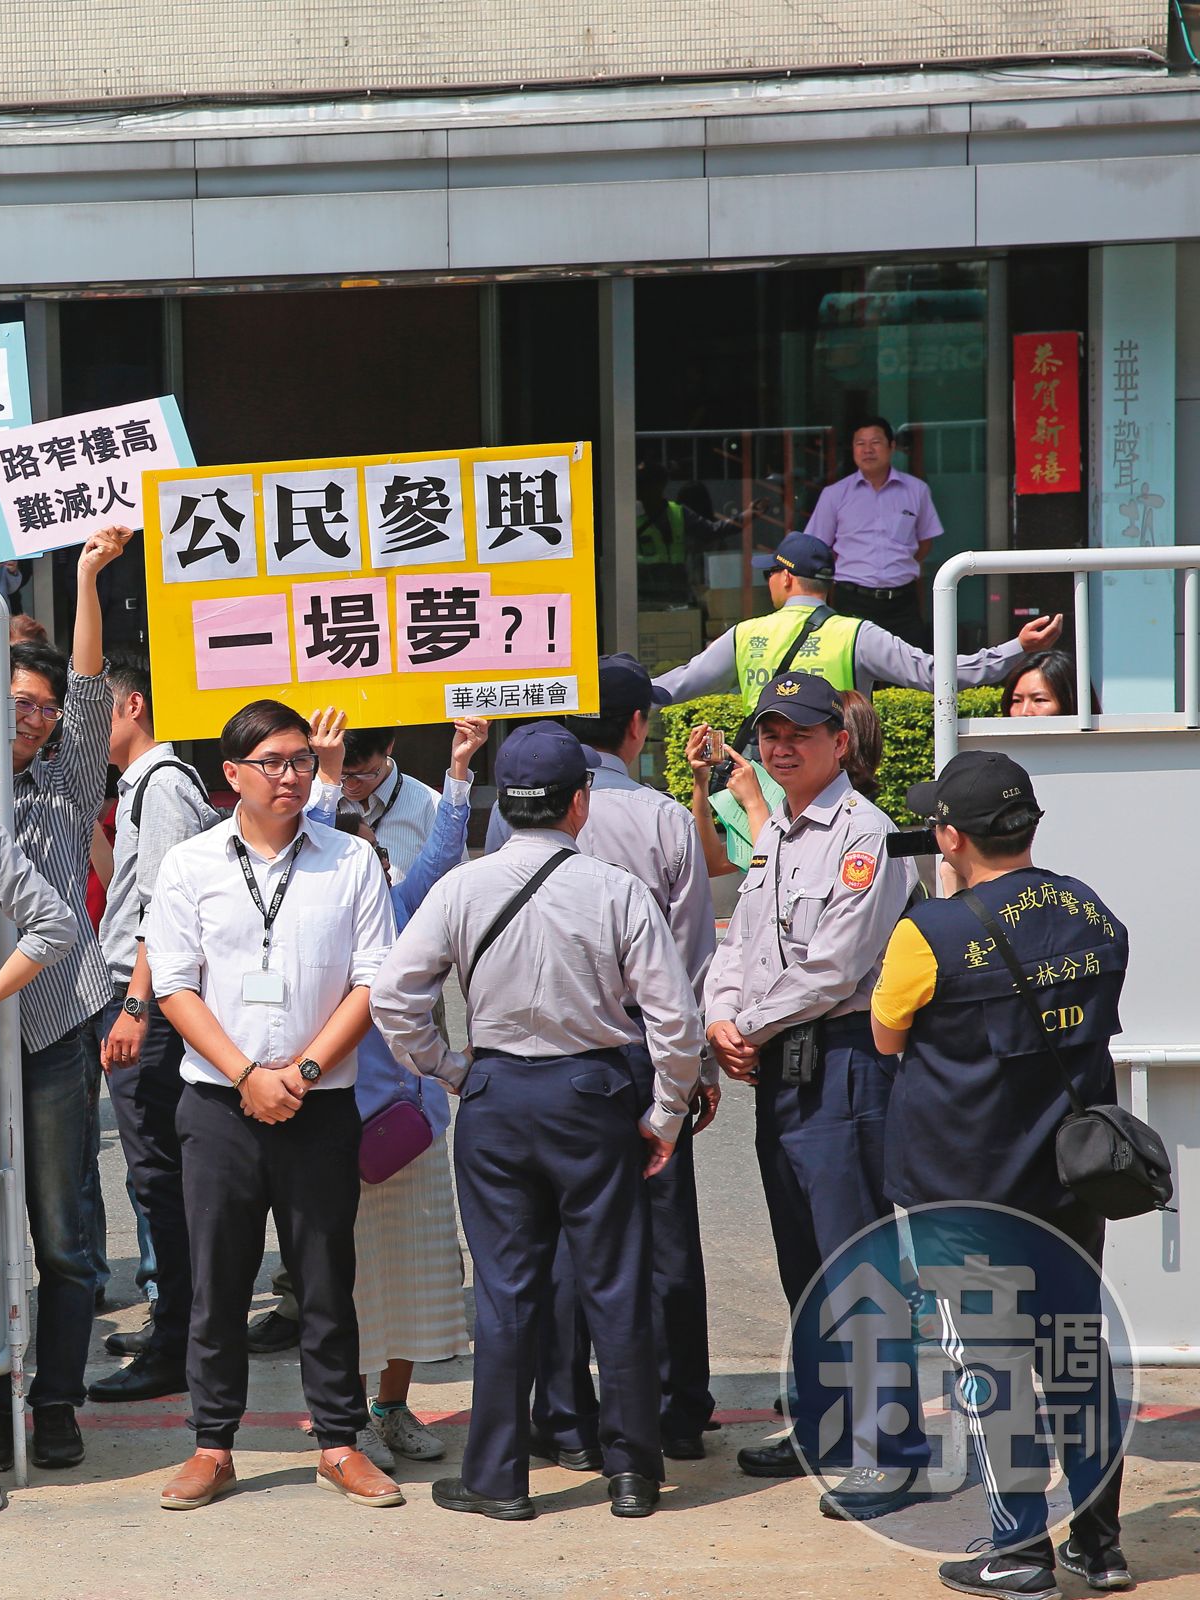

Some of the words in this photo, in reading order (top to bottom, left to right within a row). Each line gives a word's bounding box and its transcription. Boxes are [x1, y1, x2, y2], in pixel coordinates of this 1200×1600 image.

[1030, 343, 1066, 484] 恭賀新禧
[0, 419, 157, 483] 路窄樓高
[14, 476, 136, 533] 難滅火
[169, 469, 563, 569] 公民參與
[208, 586, 556, 669] 一場夢?!
[451, 681, 568, 709] 華榮居權會
[1041, 1005, 1084, 1032] CID
